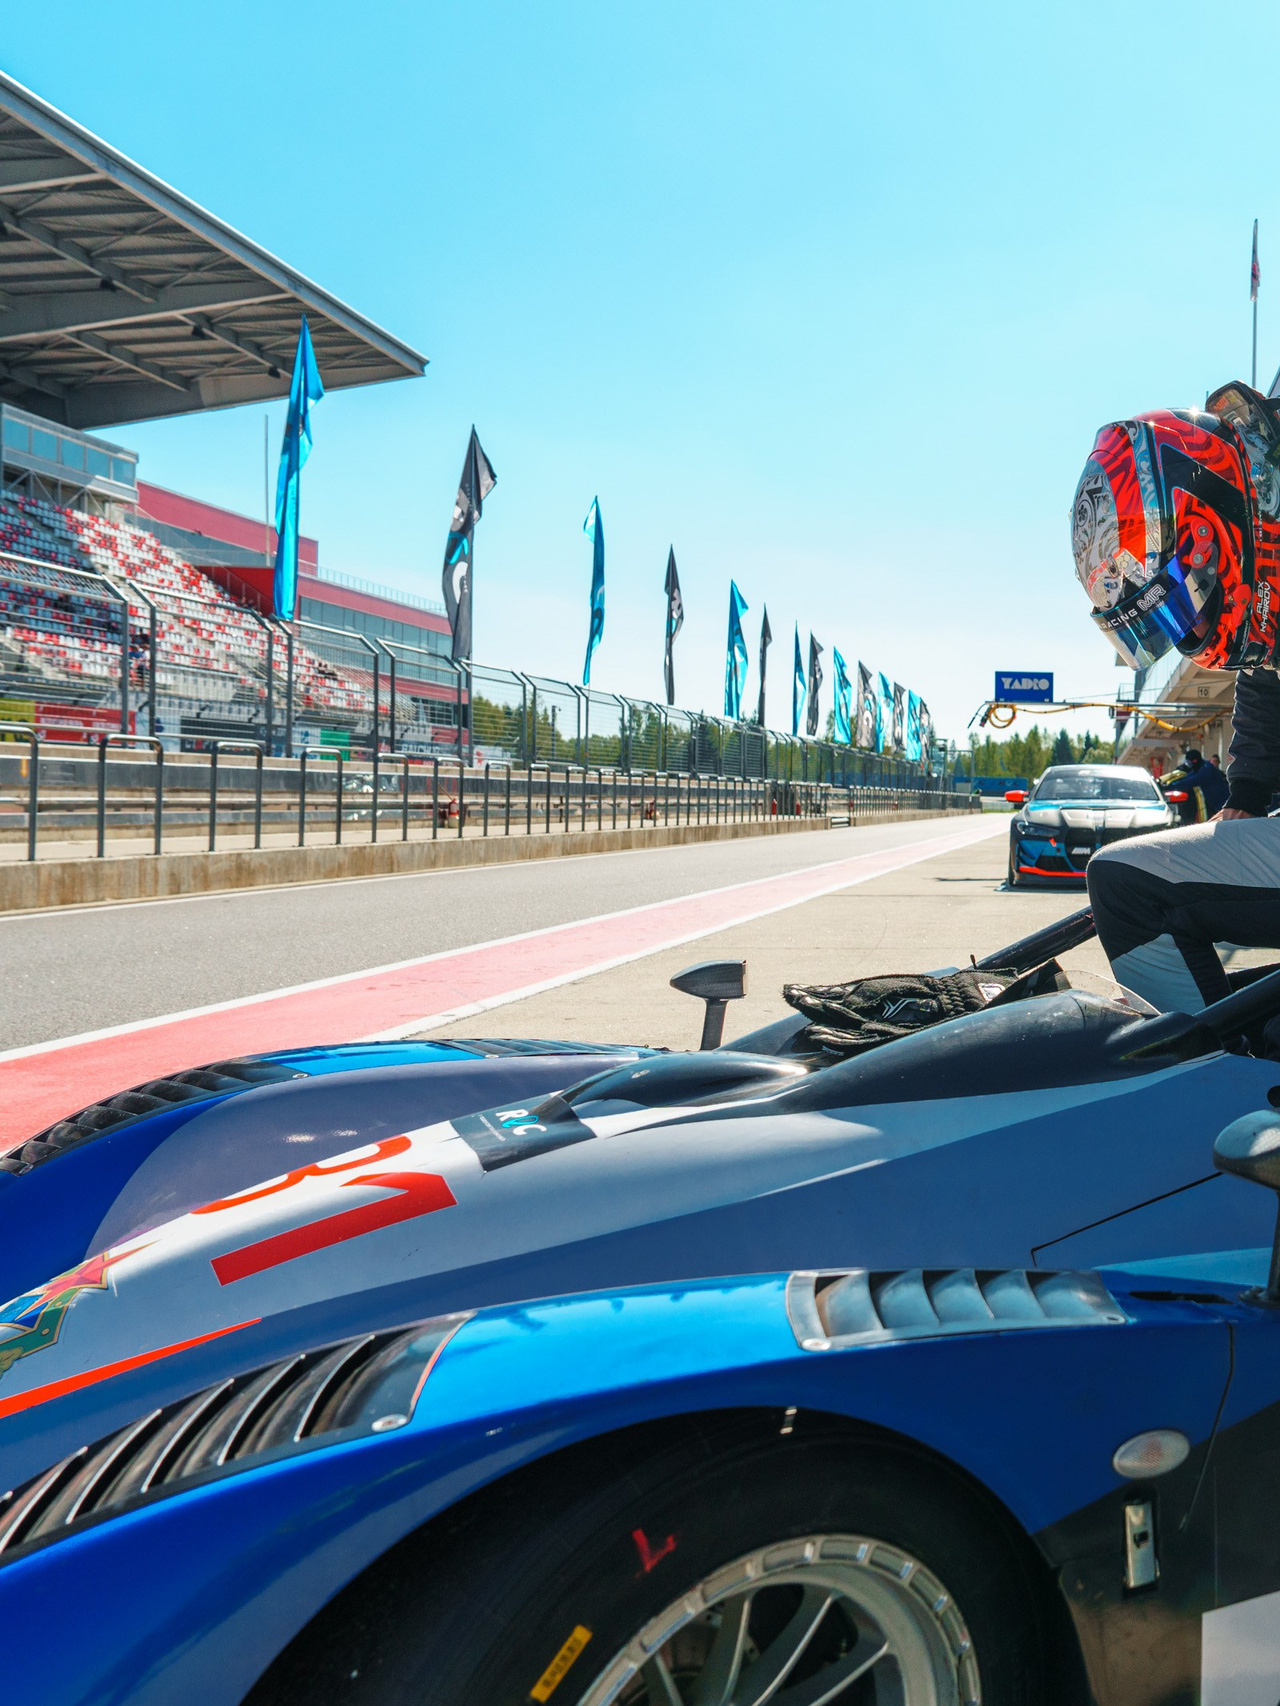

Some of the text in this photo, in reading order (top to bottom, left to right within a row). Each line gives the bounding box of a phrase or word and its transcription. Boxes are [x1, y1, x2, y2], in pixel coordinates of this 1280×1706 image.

[1100, 583, 1168, 631] RACING MR
[1256, 580, 1265, 615] ALEX
[1259, 581, 1272, 633] KHAIROV
[1001, 677, 1050, 691] YADRO
[1199, 688, 1209, 697] 10
